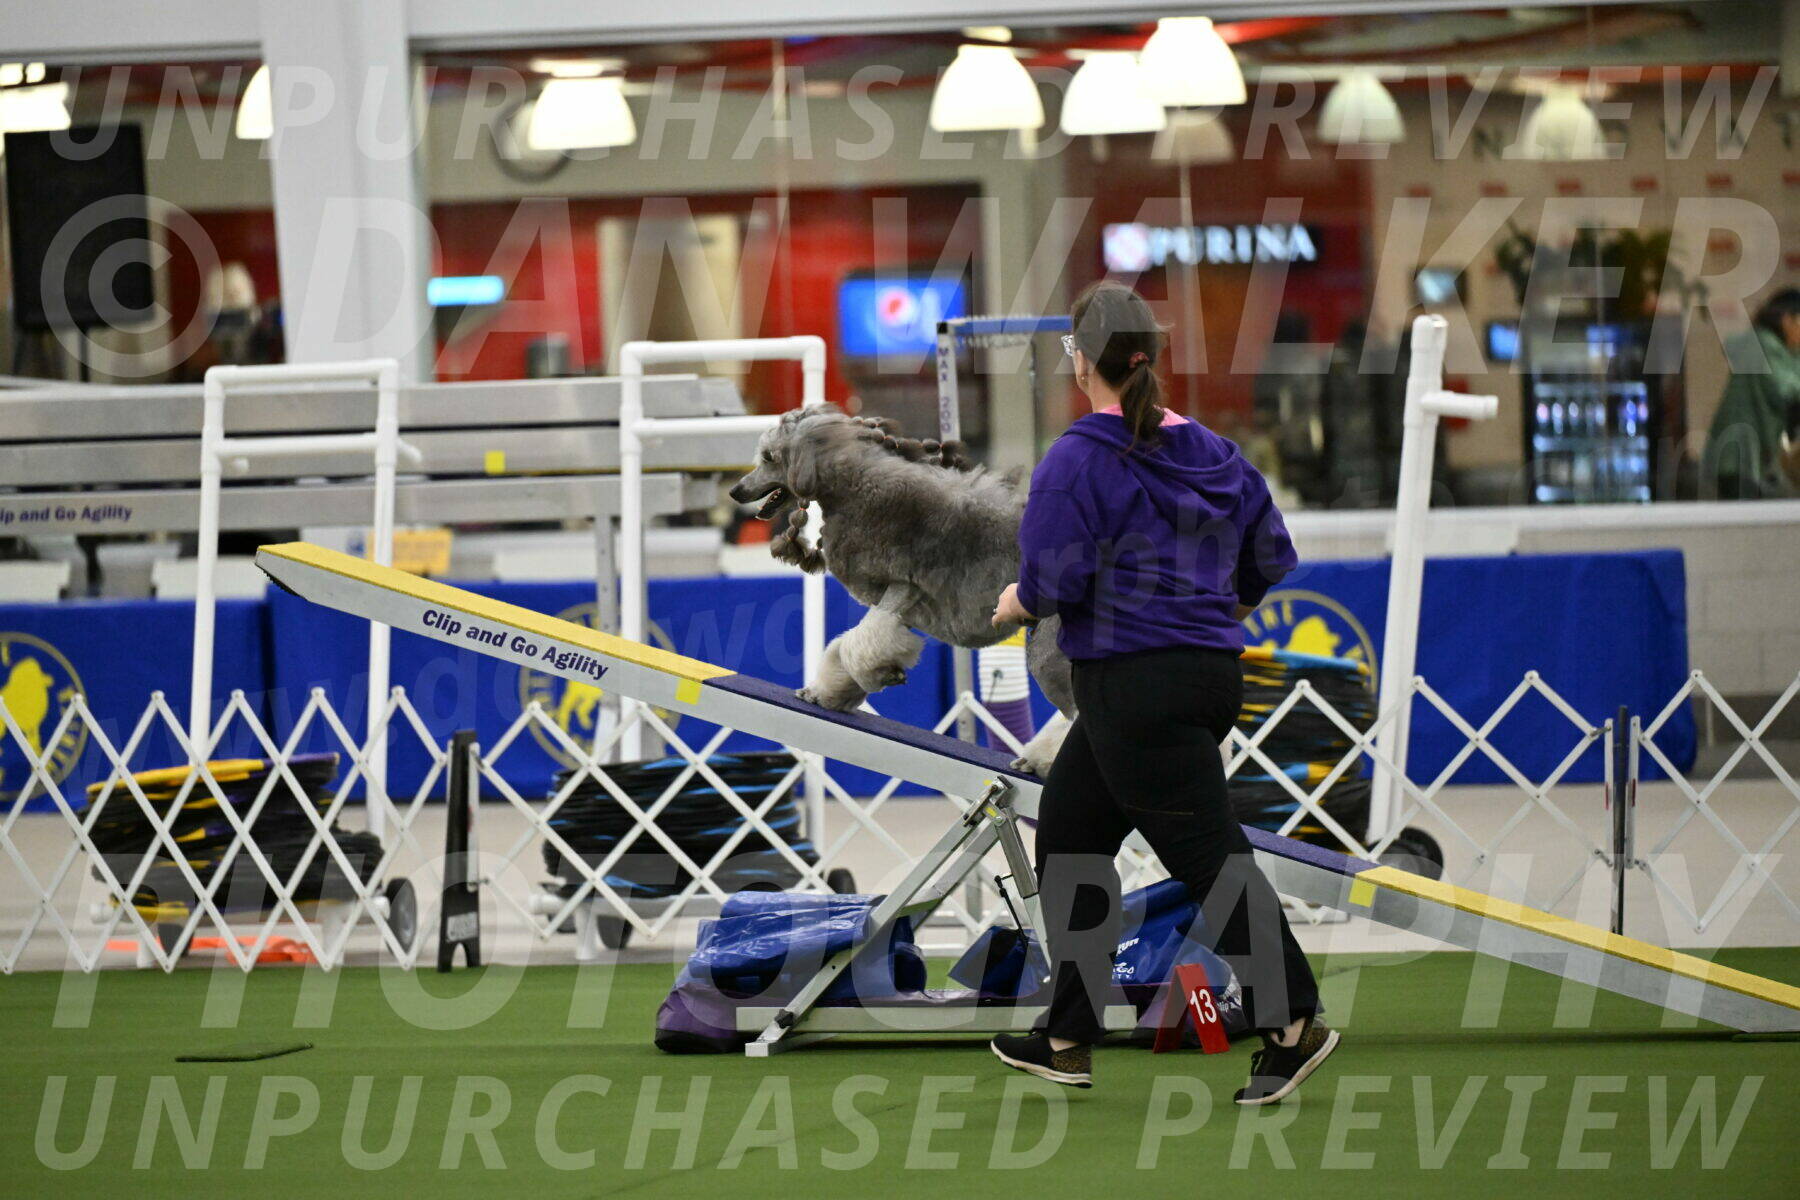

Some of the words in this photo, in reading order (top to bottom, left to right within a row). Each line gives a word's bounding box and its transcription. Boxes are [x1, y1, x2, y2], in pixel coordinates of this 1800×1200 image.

[1151, 223, 1317, 266] PURINA
[19, 505, 50, 521] and
[55, 505, 76, 520] Go
[82, 505, 132, 523] Agility
[422, 609, 462, 636] Clip
[466, 626, 508, 648] and
[510, 636, 538, 657] Go
[541, 646, 609, 681] Agility
[1189, 988, 1217, 1025] 13
